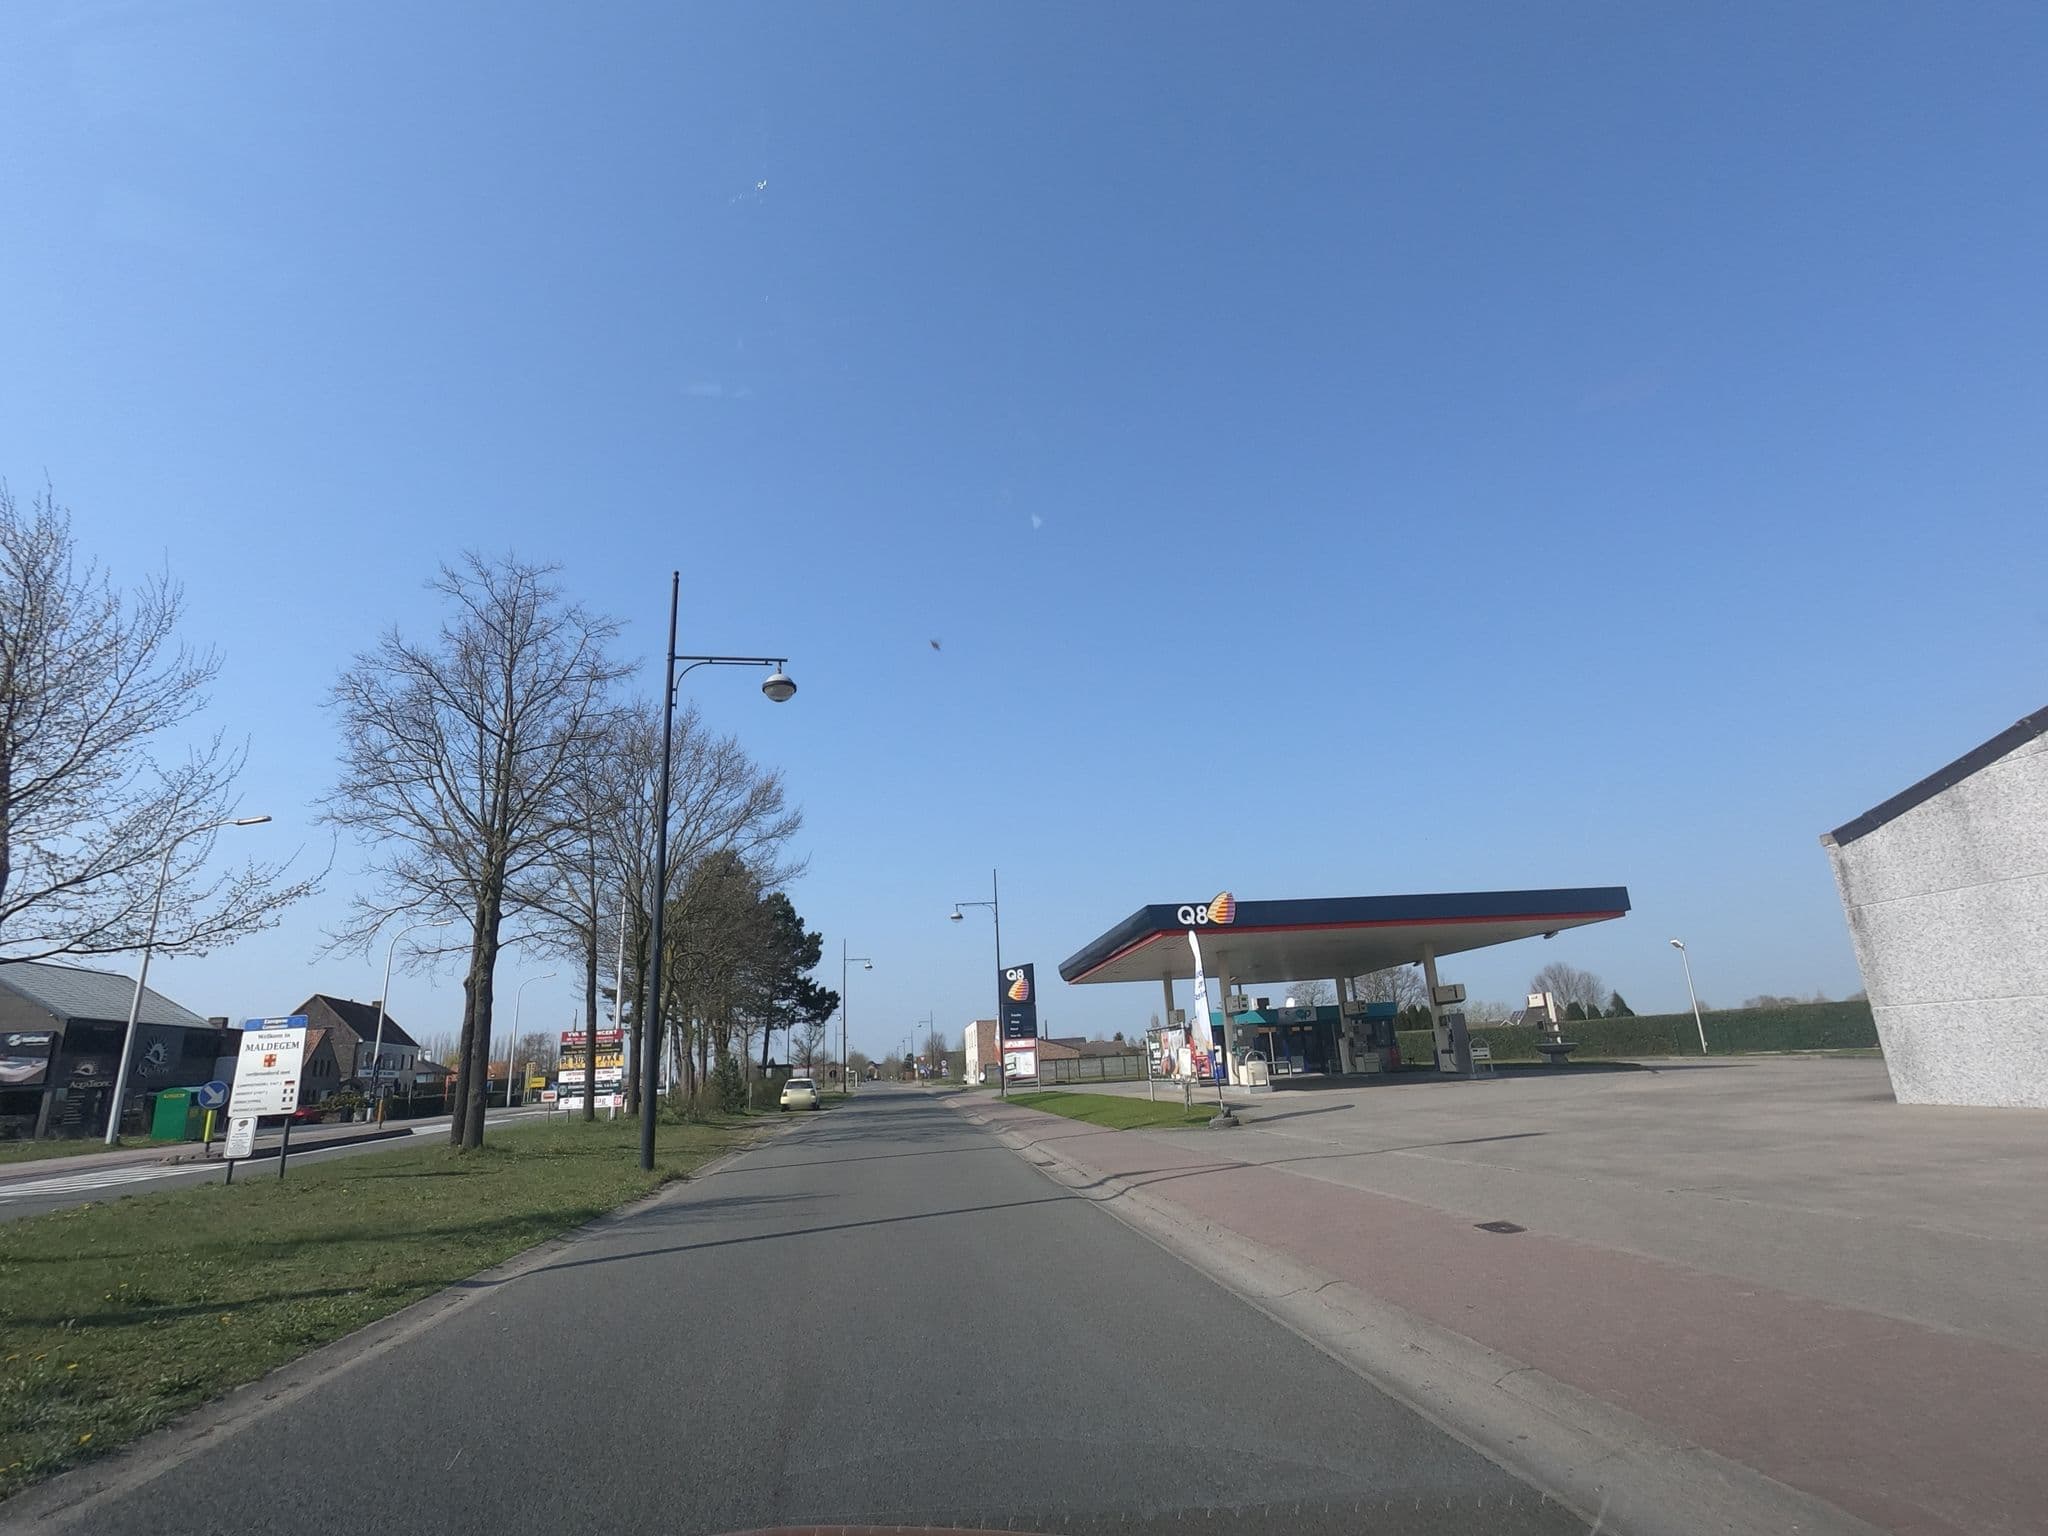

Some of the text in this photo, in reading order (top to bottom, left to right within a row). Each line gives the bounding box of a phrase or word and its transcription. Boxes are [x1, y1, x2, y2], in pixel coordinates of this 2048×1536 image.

[1177, 904, 1209, 925] Q8
[1006, 968, 1024, 982] Q8
[245, 1041, 300, 1052] MALDEGEM
